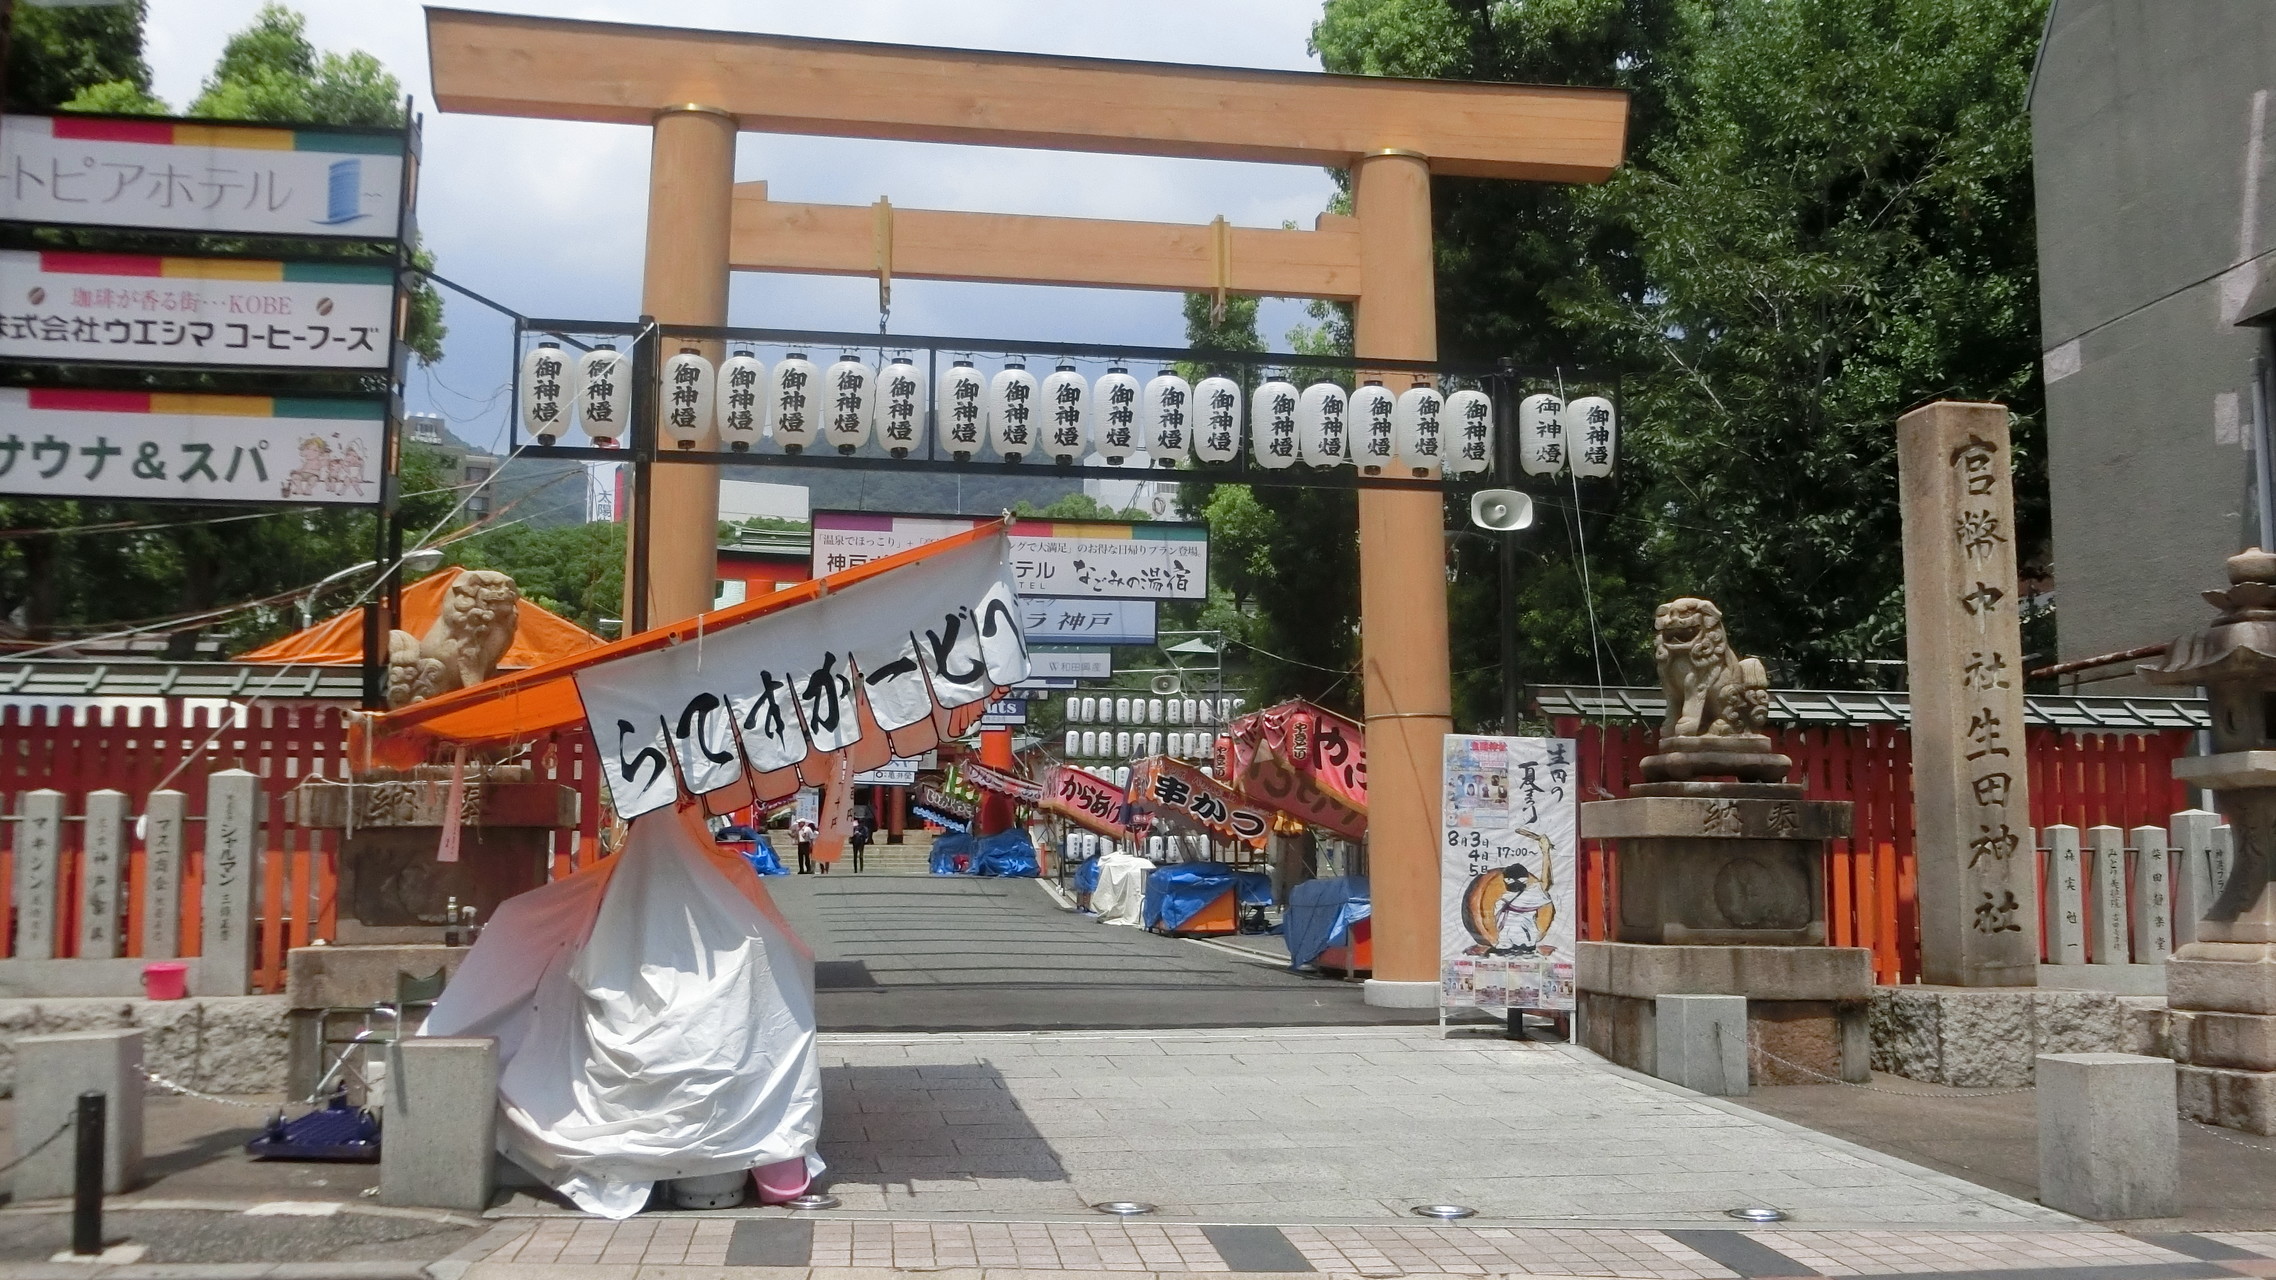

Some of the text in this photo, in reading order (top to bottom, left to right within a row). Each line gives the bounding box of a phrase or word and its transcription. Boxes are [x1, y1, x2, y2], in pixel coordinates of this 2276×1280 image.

[0, 154, 293, 212] トピアホテル
[597, 491, 612, 520] 太陽
[1010, 560, 1056, 579] テル
[1155, 775, 1265, 837] 串かつ
